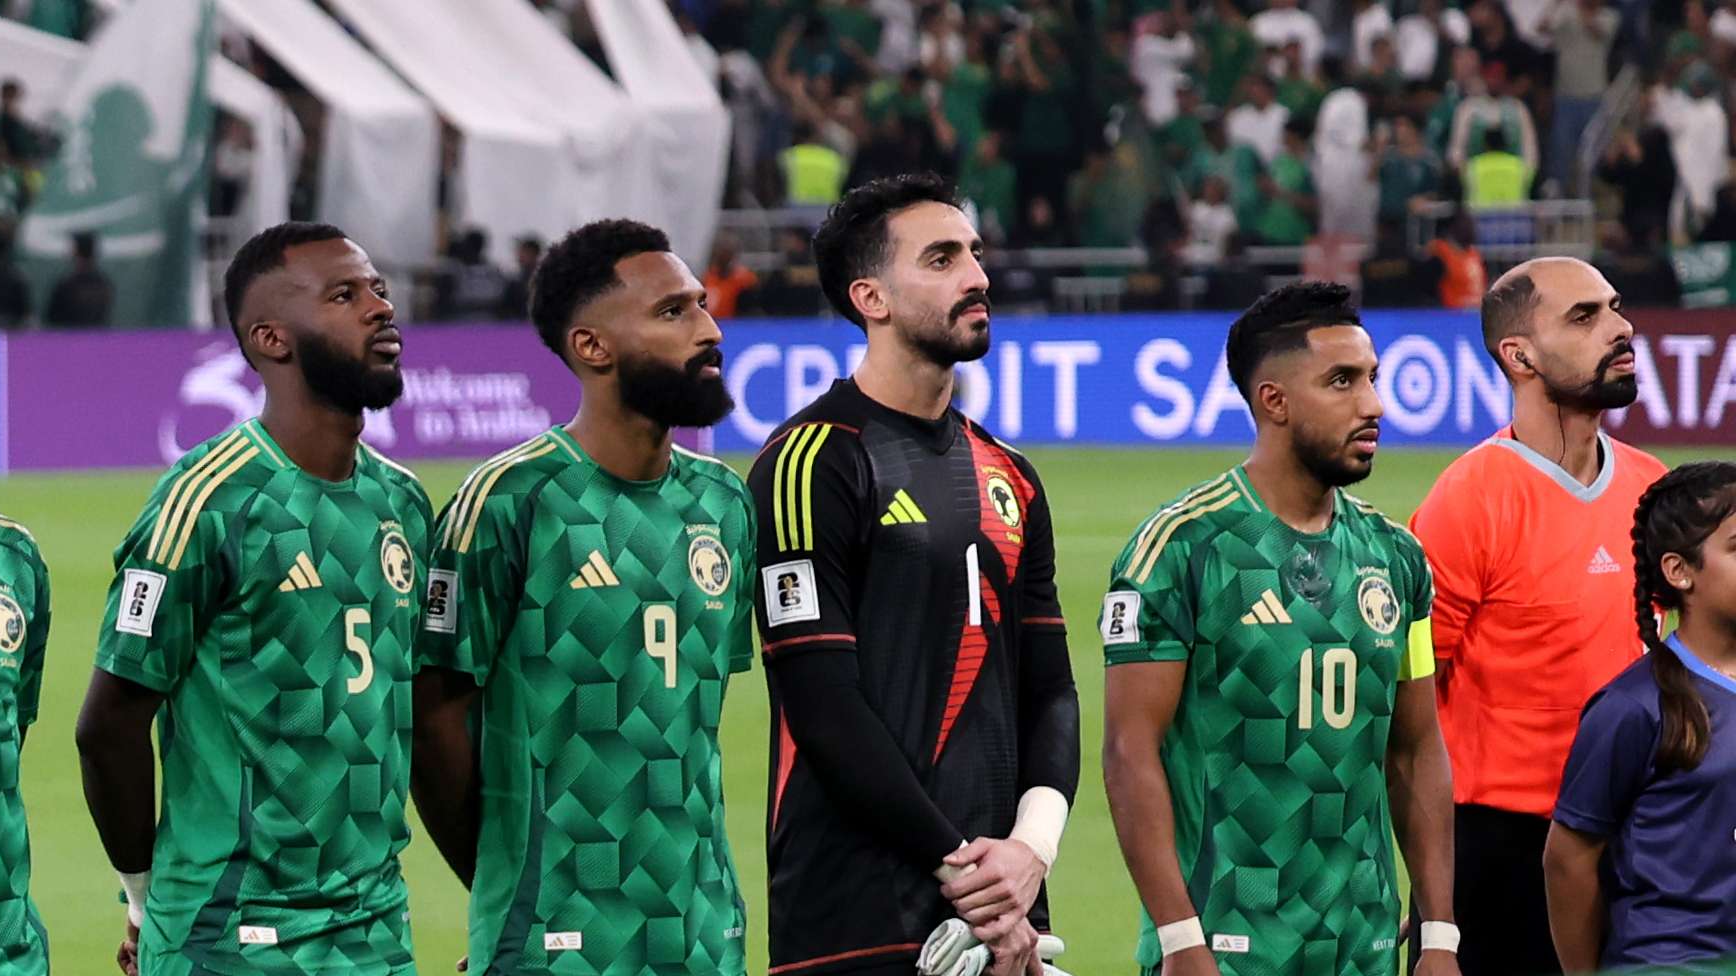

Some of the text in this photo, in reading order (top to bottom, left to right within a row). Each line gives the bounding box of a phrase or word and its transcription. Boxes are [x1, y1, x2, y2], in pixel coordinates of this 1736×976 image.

[728, 337, 1514, 444] CRIT SAON
[966, 543, 982, 626] 1
[344, 608, 374, 694] 5
[643, 604, 678, 688] 9
[1298, 648, 1357, 730] 10
